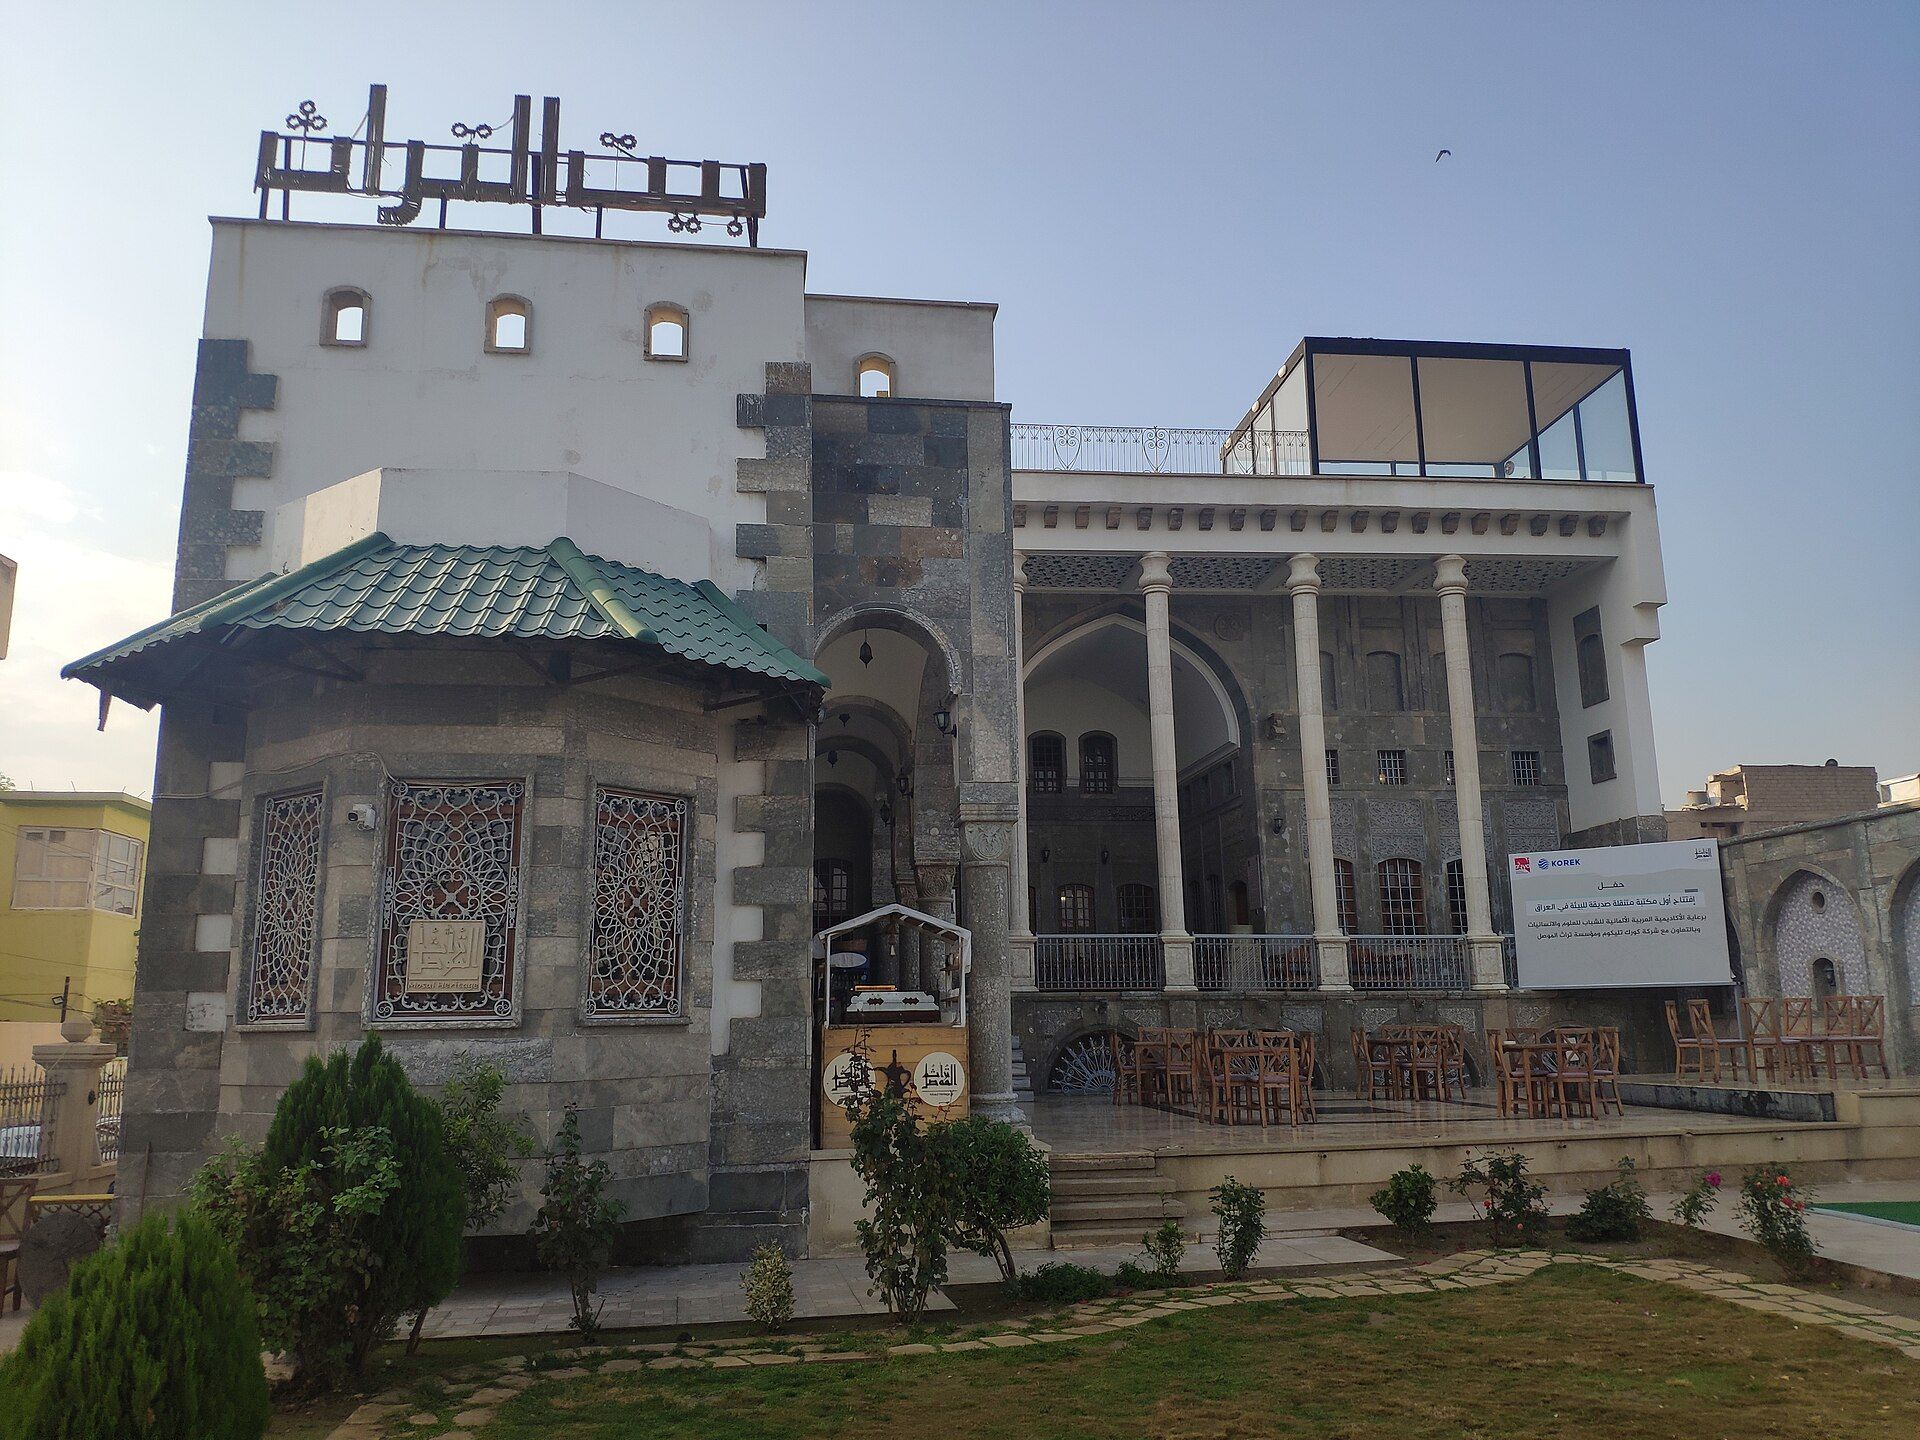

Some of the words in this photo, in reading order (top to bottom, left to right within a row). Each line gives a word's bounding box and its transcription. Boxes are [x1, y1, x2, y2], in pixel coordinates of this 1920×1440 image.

[1551, 858, 1581, 867] KOREK
[1635, 898, 1658, 907] مكتبة
[1658, 894, 1671, 906] أول
[1673, 896, 1696, 906] إفتتاح
[1534, 903, 1556, 913] العراق
[1557, 903, 1569, 912] في
[1569, 901, 1588, 911] للبيئة
[1588, 901, 1612, 909] صديقة
[1582, 918, 1605, 927] للشباب
[1605, 916, 1630, 925] الألمانية
[1631, 916, 1653, 924] العربية
[1654, 913, 1685, 923] الأكاديمية
[1686, 914, 1707, 922] برعاية
[1561, 920, 1581, 928] للعلوم
[1559, 931, 1573, 939] تراث
[1602, 929, 1623, 938] تليكوم
[1624, 928, 1641, 936] كورك
[1642, 927, 1660, 935] شركة
[1670, 926, 1701, 935] وبالتعاون
[1536, 932, 1558, 941] الموصل
